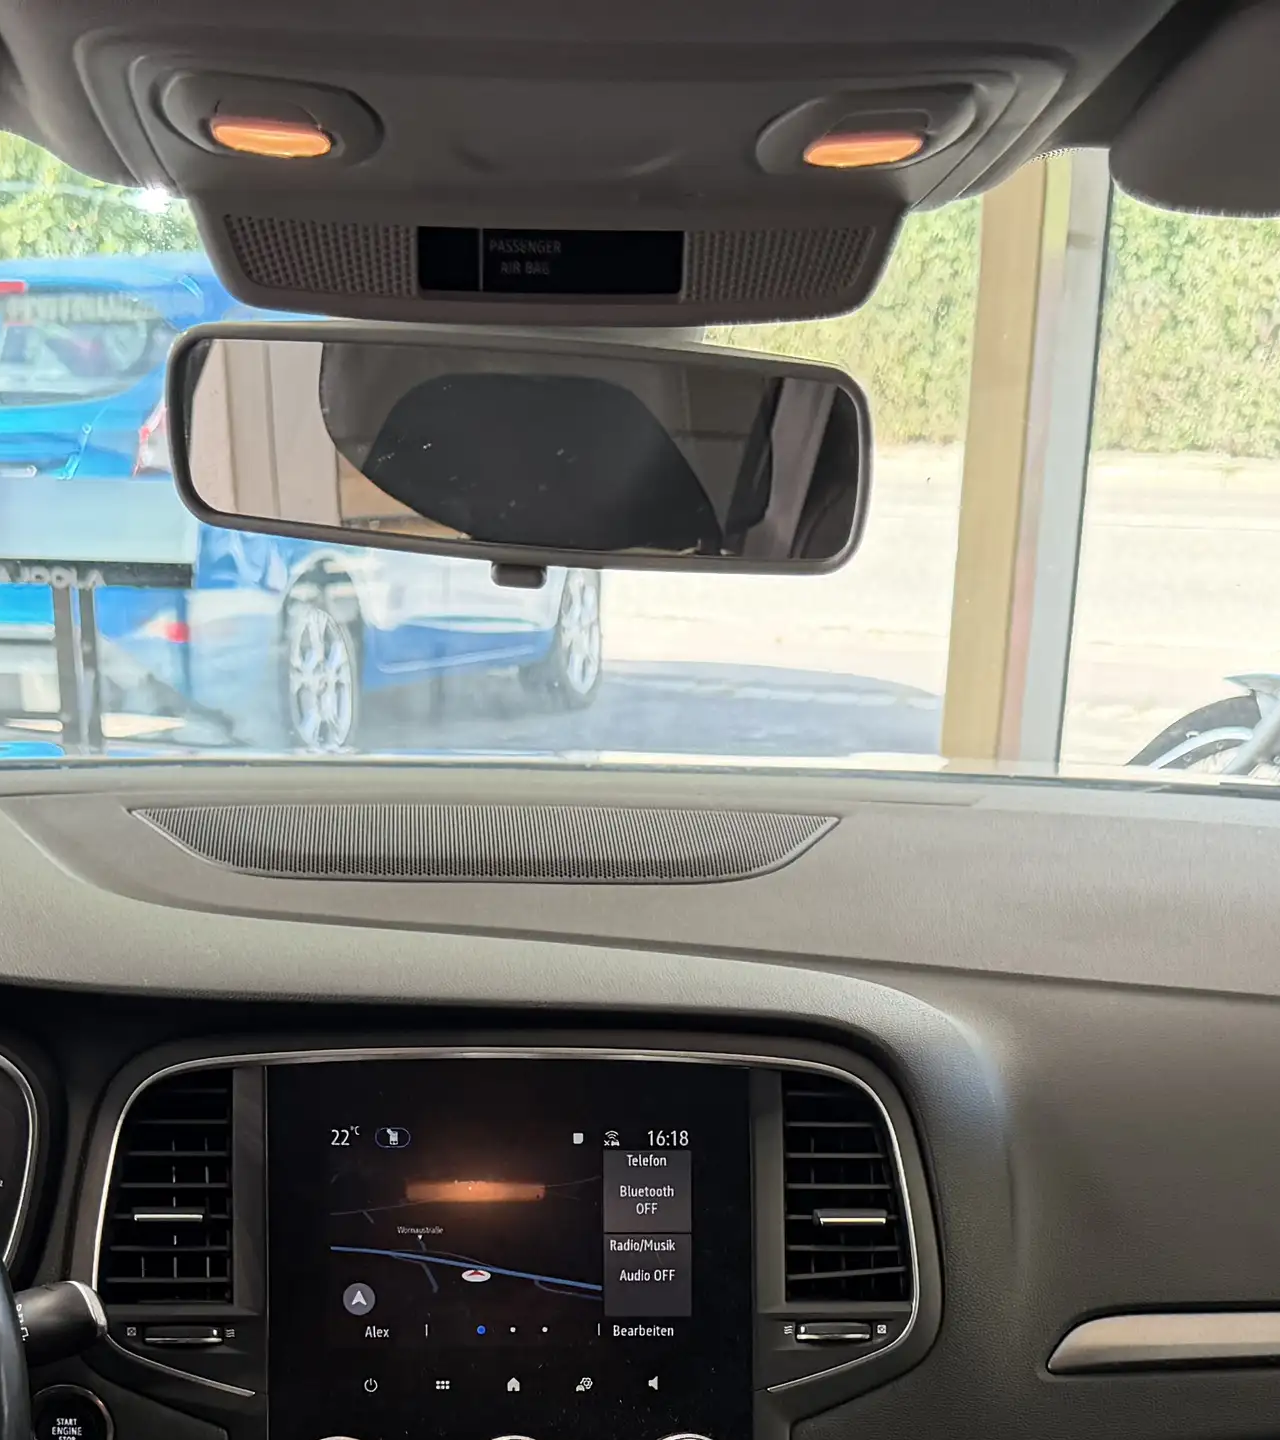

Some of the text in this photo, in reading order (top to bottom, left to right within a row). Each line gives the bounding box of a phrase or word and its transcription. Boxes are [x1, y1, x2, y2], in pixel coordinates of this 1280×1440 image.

[489, 238, 562, 253] PASSENGER
[500, 260, 550, 275] AIR BAG
[648, 1130, 689, 1146] 16:18
[626, 1154, 667, 1167] Telefon
[619, 1185, 675, 1197] Bluetooth
[636, 1202, 658, 1215] OFF
[609, 1239, 676, 1252] Radio/Musik
[619, 1269, 676, 1282] Audio OFF
[365, 1325, 390, 1338] Alex
[613, 1324, 674, 1337] Bearbeiten
[56, 1417, 77, 1426] START
[51, 1426, 83, 1436] ENGINE
